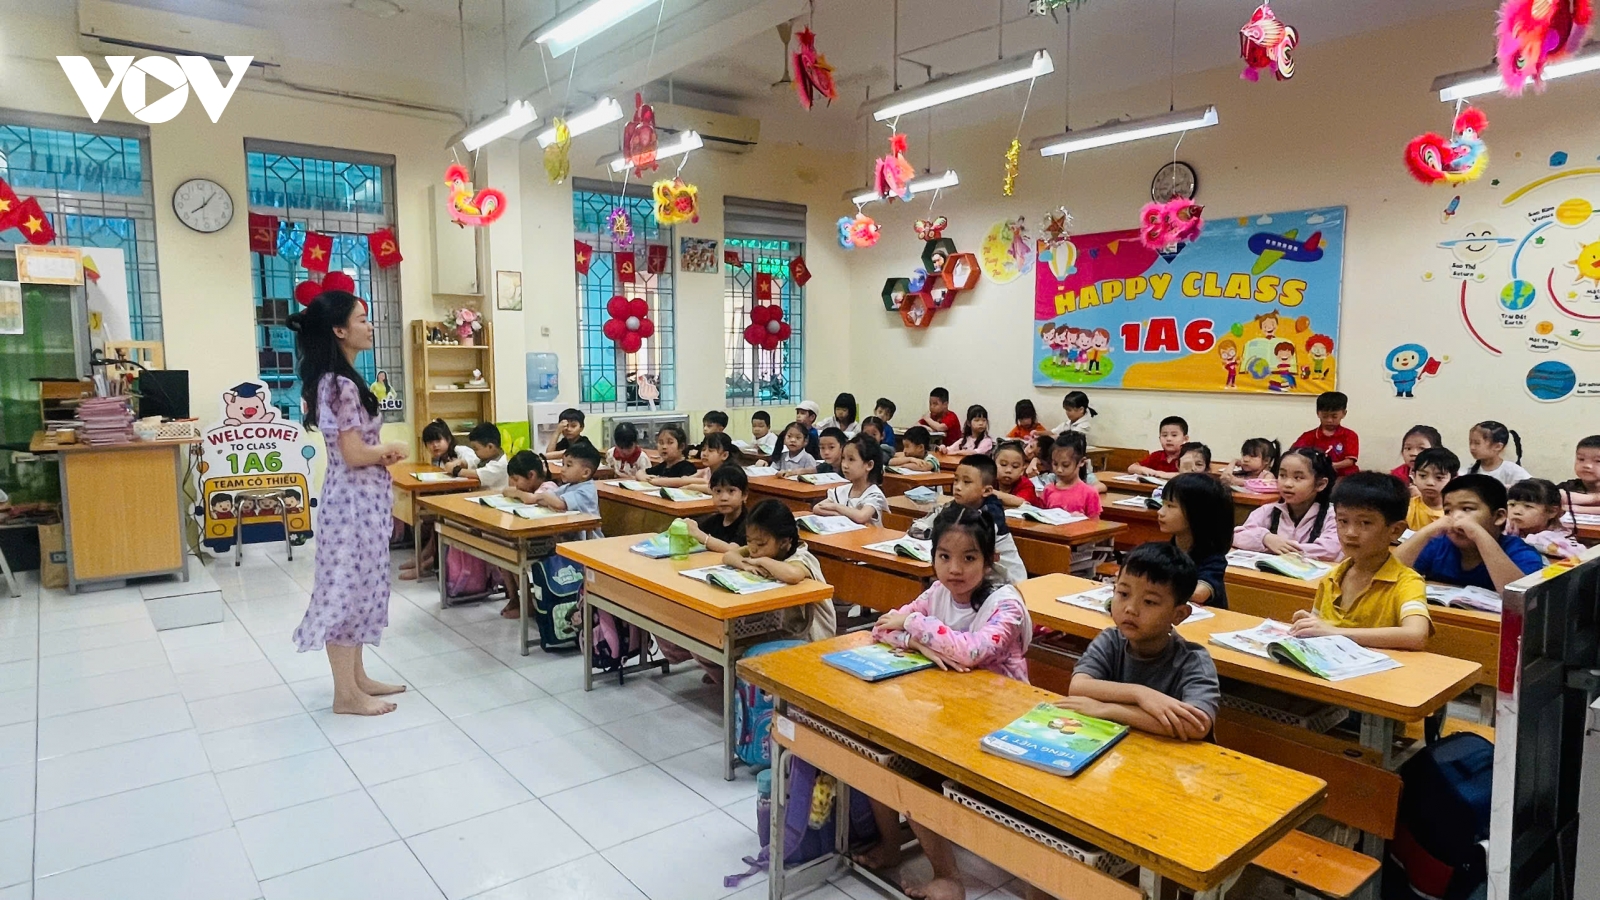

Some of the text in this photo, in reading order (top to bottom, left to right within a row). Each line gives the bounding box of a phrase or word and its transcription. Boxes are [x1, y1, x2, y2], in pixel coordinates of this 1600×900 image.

[1054, 271, 1307, 315] HAPPY CLASS
[1120, 316, 1216, 353] 1A6
[207, 427, 298, 446] WELCOME!
[230, 442, 277, 451] TO CLASS
[225, 451, 283, 474] 1A6
[213, 479, 244, 489] TEAM
